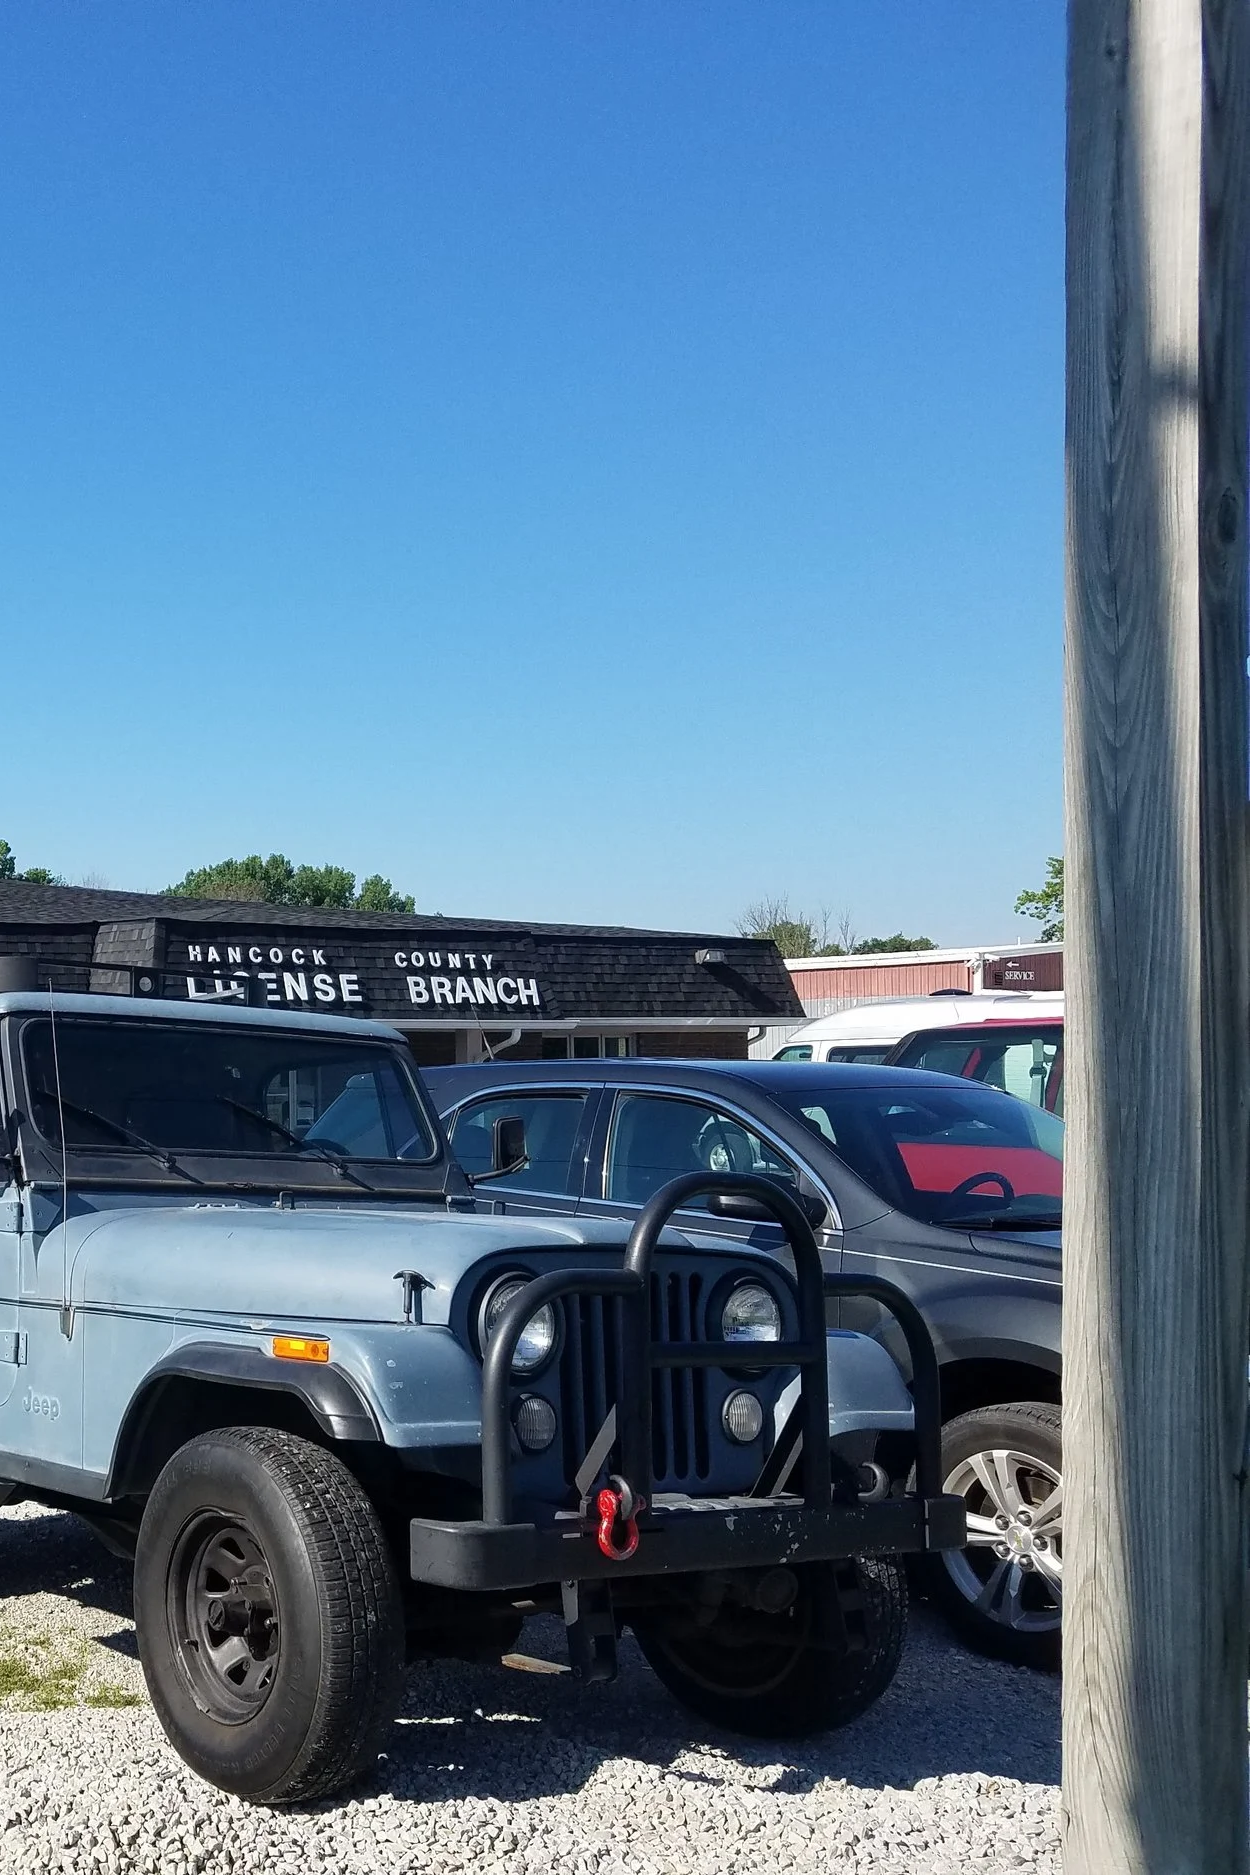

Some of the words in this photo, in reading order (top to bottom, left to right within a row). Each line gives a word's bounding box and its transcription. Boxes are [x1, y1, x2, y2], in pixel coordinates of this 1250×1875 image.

[188, 945, 327, 965] HANCOCK
[394, 951, 493, 971] COUNTY
[1004, 971, 1035, 980] SERVICE
[406, 975, 540, 1006] BRANCH
[22, 1386, 60, 1422] Jeep
